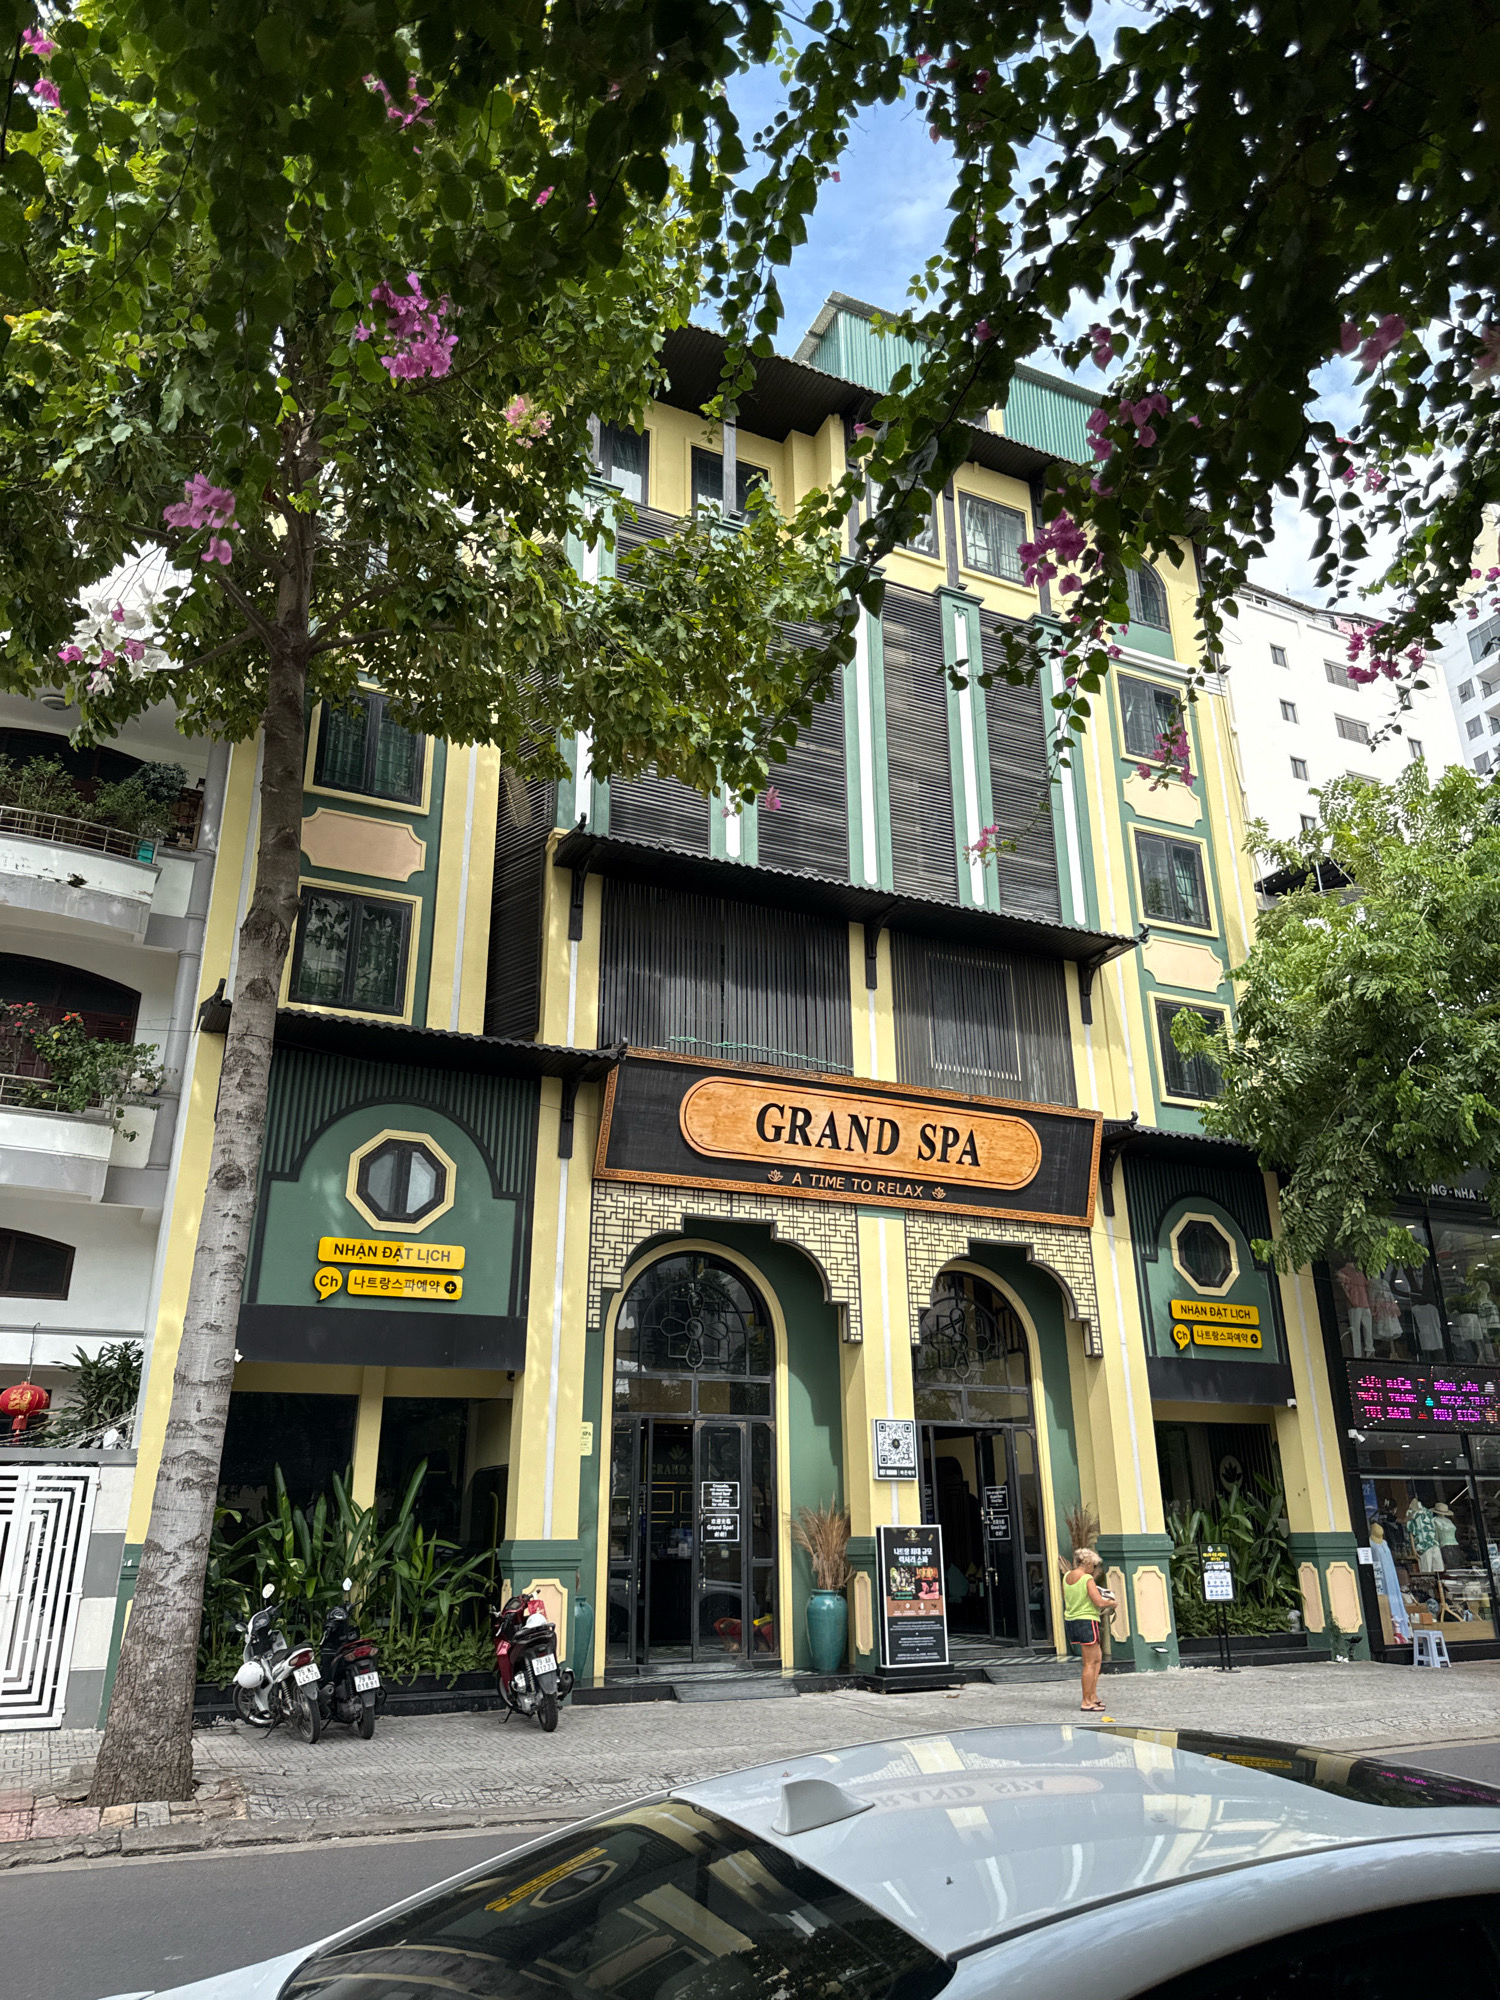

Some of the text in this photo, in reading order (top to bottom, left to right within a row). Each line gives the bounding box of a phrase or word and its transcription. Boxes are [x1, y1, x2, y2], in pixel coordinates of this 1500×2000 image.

[755, 1102, 982, 1167] GRAND SPA
[792, 1173, 924, 1198] A TIME TO RELAX
[333, 1242, 451, 1264] NHẬN ĐẶT LỊCH
[319, 1275, 338, 1288] Ch
[353, 1275, 441, 1293] 나트랑스파예약
[1180, 1303, 1251, 1320] NHẬN ĐẶT LỊCH
[1176, 1330, 1188, 1340] Ch
[1196, 1330, 1249, 1343] 나트랑스파예약
